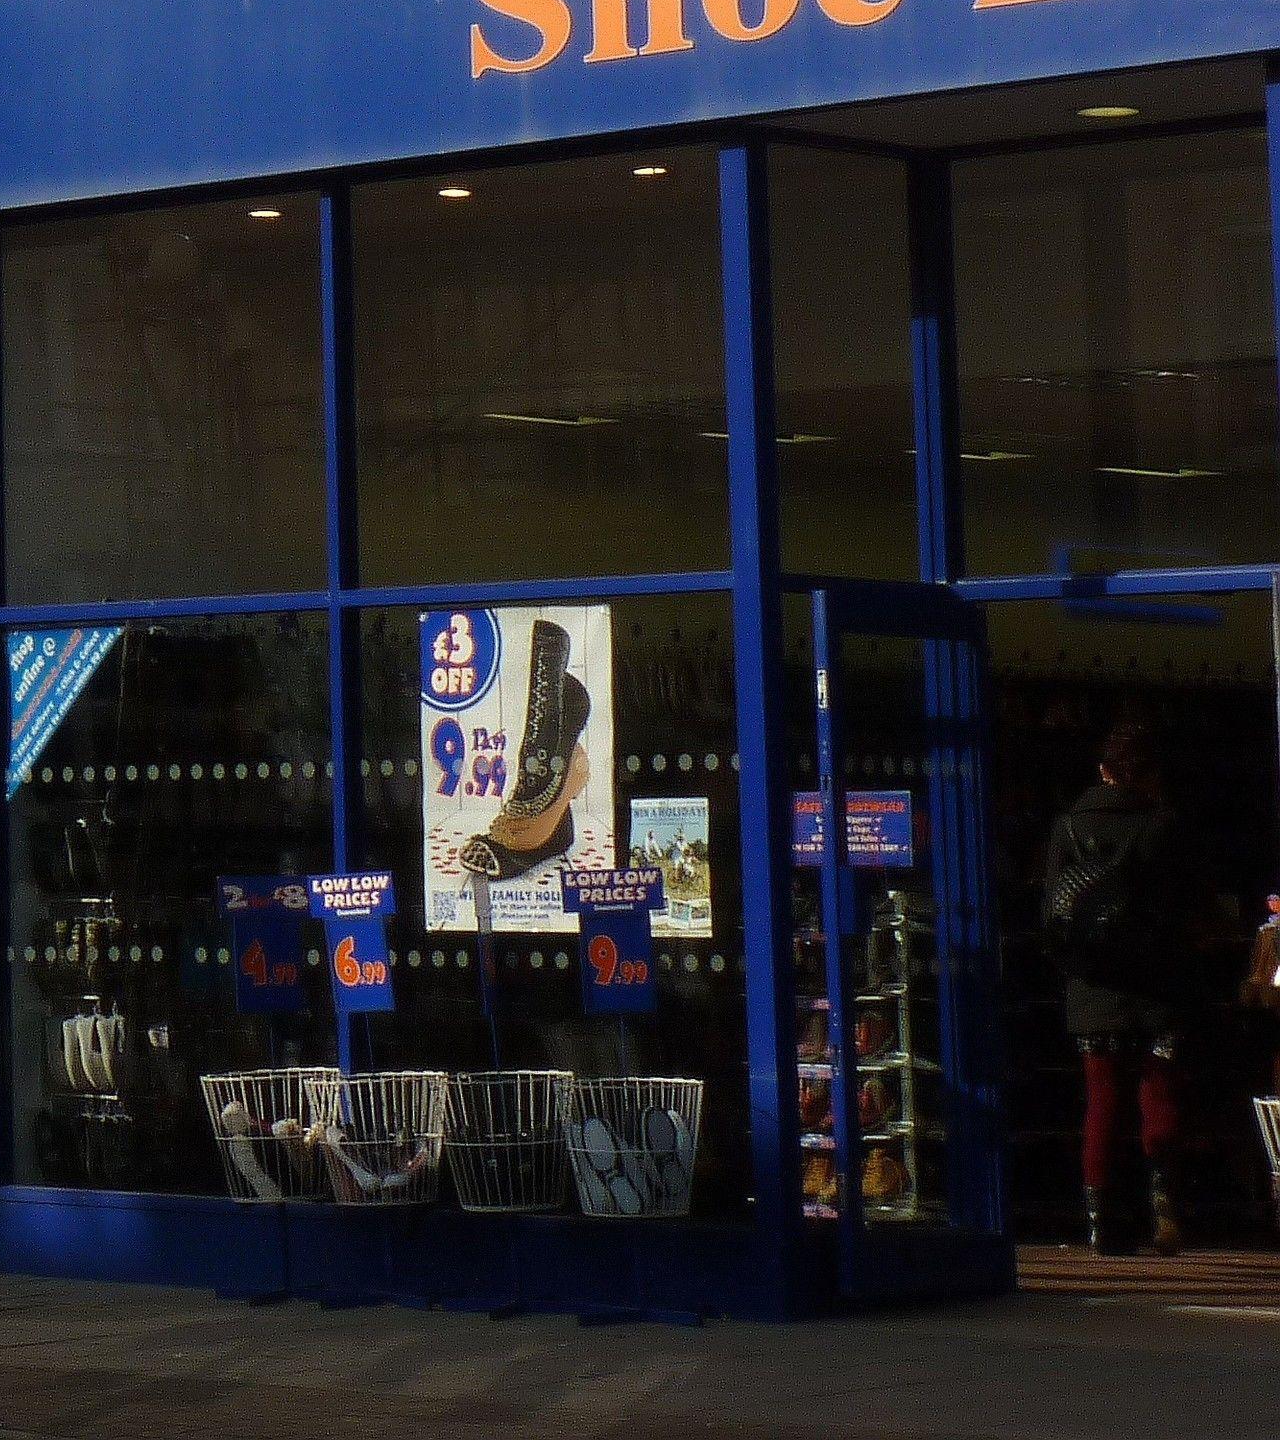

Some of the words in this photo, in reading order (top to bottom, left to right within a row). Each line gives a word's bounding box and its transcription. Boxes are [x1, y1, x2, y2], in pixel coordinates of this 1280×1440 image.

[10, 635, 35, 671] shop
[431, 612, 477, 666] £3
[14, 655, 46, 702] online
[42, 637, 56, 657] @
[430, 666, 478, 695] OFF
[430, 716, 507, 798] 9.99
[312, 877, 350, 894] LOW
[350, 875, 390, 891] LOW
[564, 872, 609, 888] LOW
[613, 869, 659, 885] LOW
[579, 885, 647, 903] PRICES
[323, 891, 380, 909] PRICES
[492, 890, 531, 902] FAMILY
[334, 935, 388, 987] 6.99
[588, 934, 648, 987] 9.99
